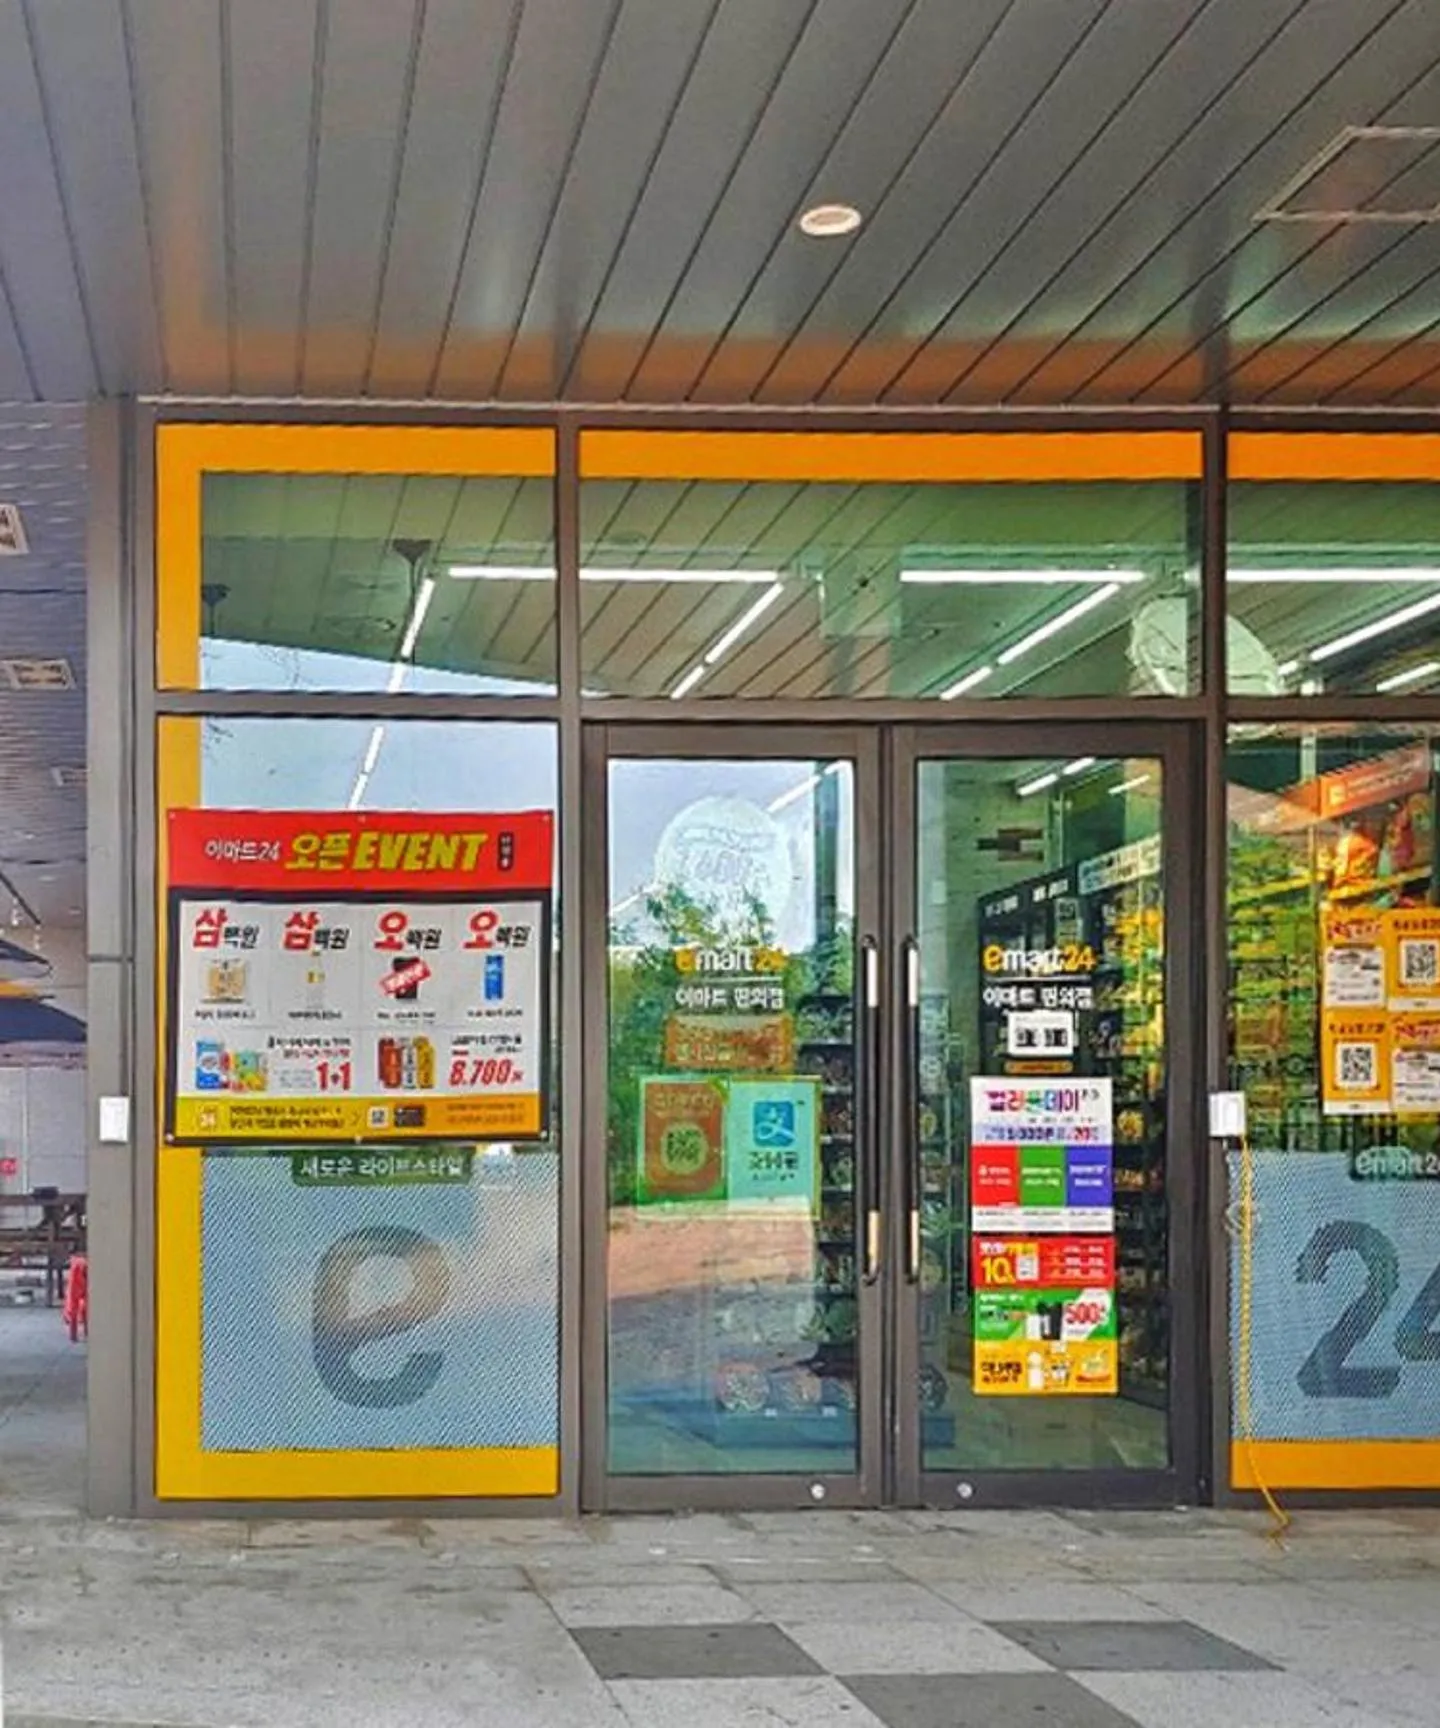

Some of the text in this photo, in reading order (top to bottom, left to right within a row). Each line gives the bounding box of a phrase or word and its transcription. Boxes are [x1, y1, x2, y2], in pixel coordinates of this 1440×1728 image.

[983, 944, 1097, 973] emart24
[675, 986, 727, 1009] 이마트
[982, 986, 1036, 1008] 이마트
[358, 1154, 464, 1176] 라이프스타일
[312, 1225, 452, 1409] e
